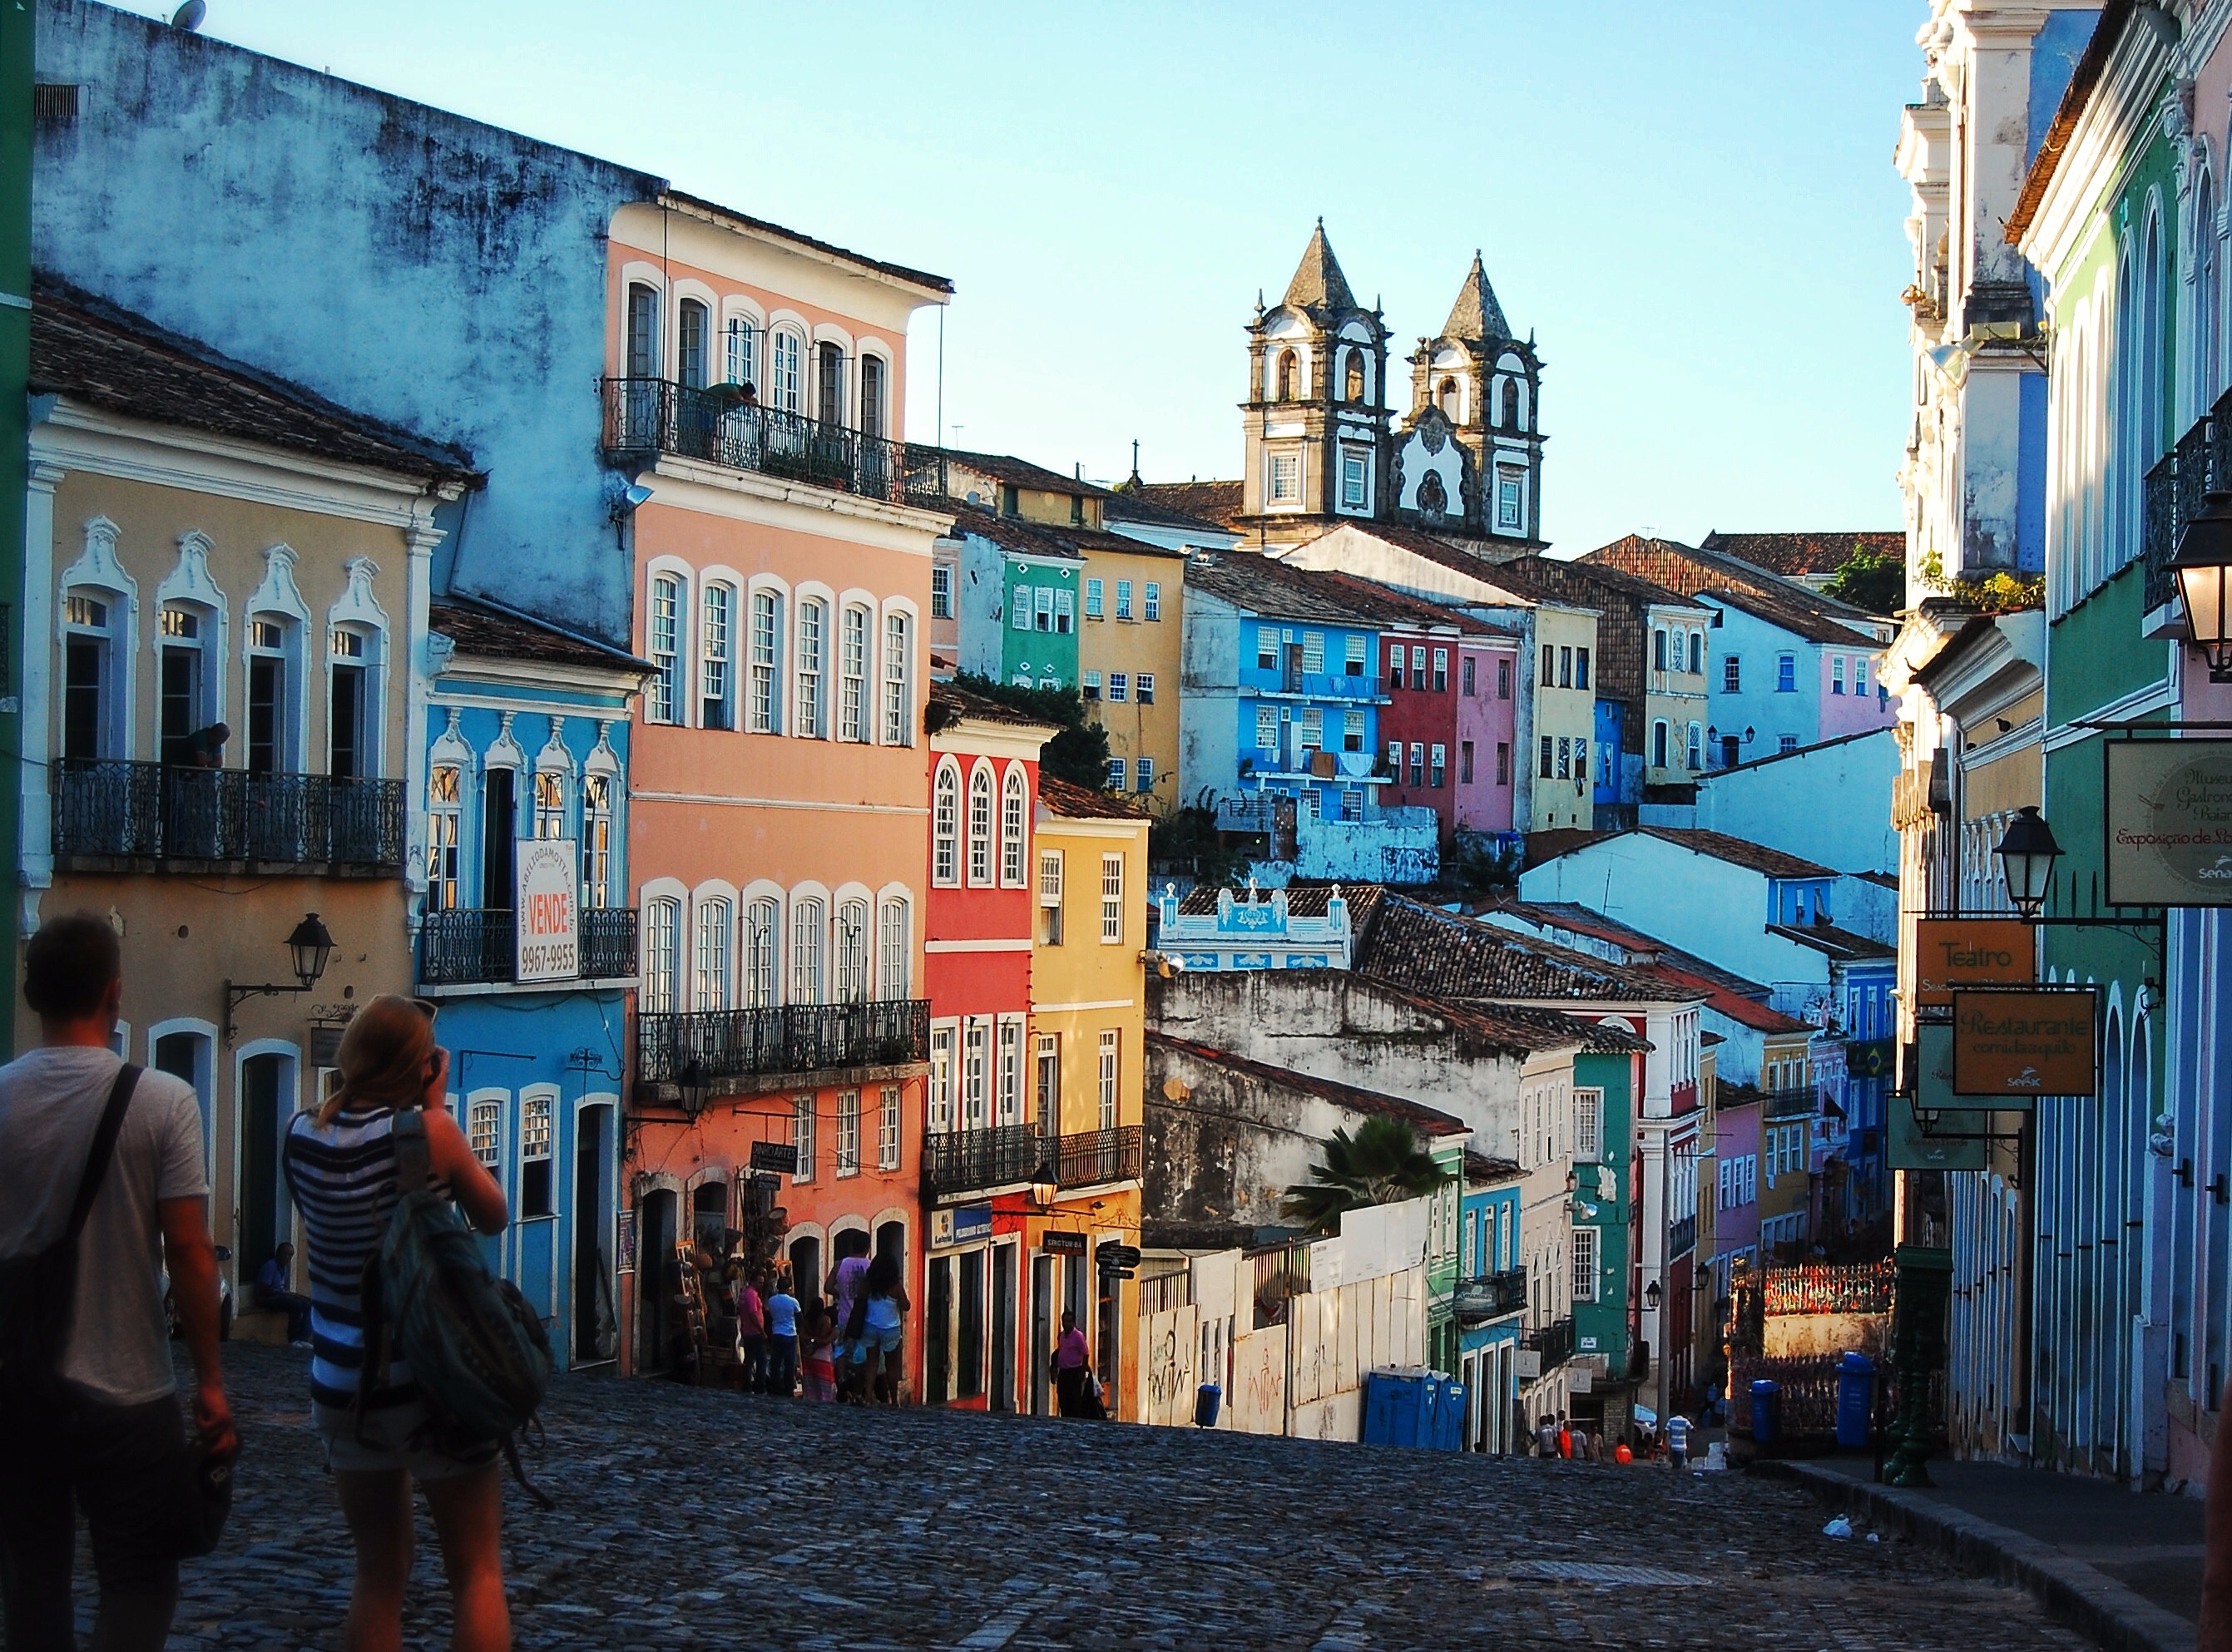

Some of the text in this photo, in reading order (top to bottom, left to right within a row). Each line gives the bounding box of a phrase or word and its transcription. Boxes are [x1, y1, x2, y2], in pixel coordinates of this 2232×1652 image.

[2184, 768, 2232, 784] Museu
[2116, 828, 2190, 852] Exposição
[2191, 828, 2212, 844] de
[528, 893, 568, 935] VENDE
[522, 943, 575, 974] 9967-9955
[1938, 942, 2013, 968] Teatro
[1960, 1009, 2088, 1036] Restaurante
[1973, 1039, 2027, 1054] comida
